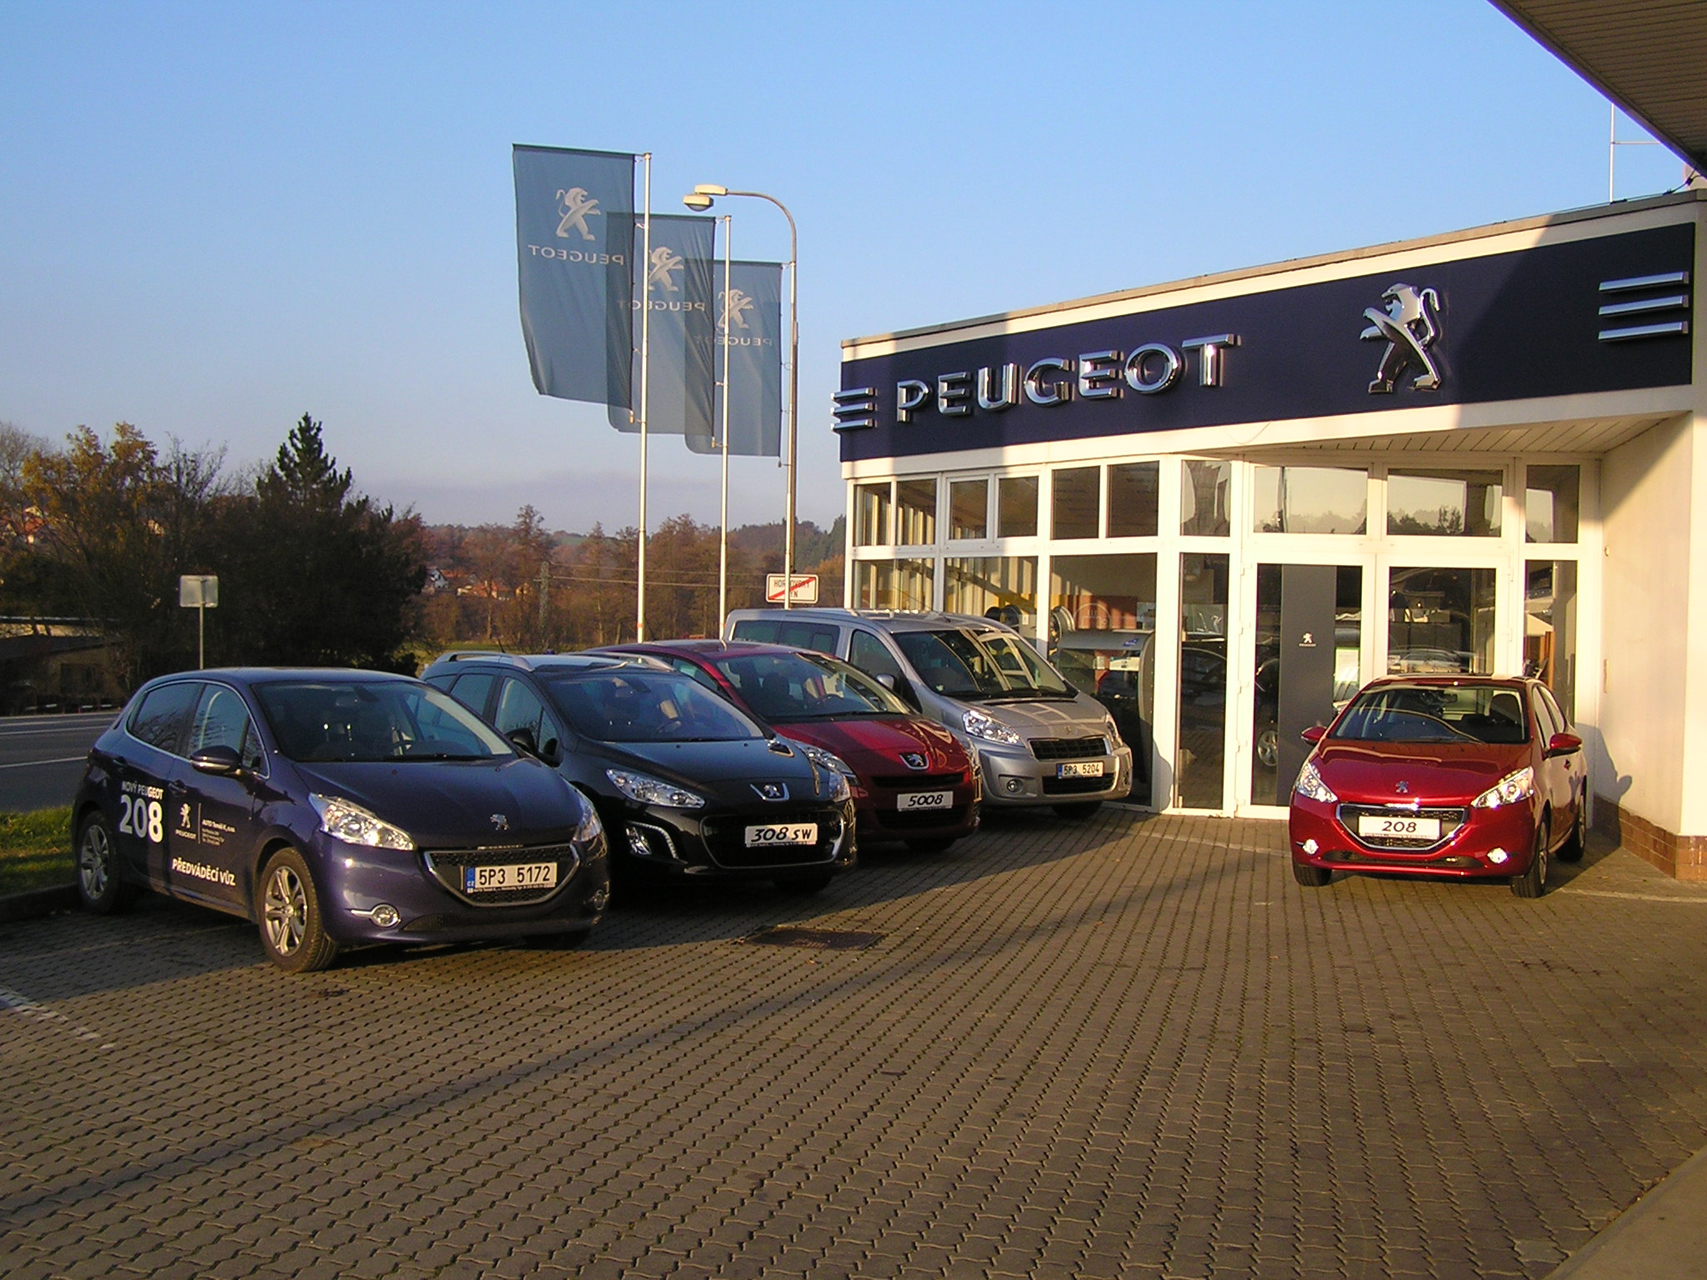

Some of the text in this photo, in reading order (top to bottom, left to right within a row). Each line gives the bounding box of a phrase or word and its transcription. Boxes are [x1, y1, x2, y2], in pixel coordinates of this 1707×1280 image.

[896, 333, 1239, 423] PEUGEOT
[137, 783, 164, 800] PEUGEOT
[907, 793, 944, 807] 5008
[119, 793, 164, 843] 208
[1381, 820, 1417, 833] 208
[750, 826, 812, 842] 308 SW
[171, 856, 219, 882] PŘEDVÁDĚCÍ
[479, 865, 550, 886] 5P3 5172
